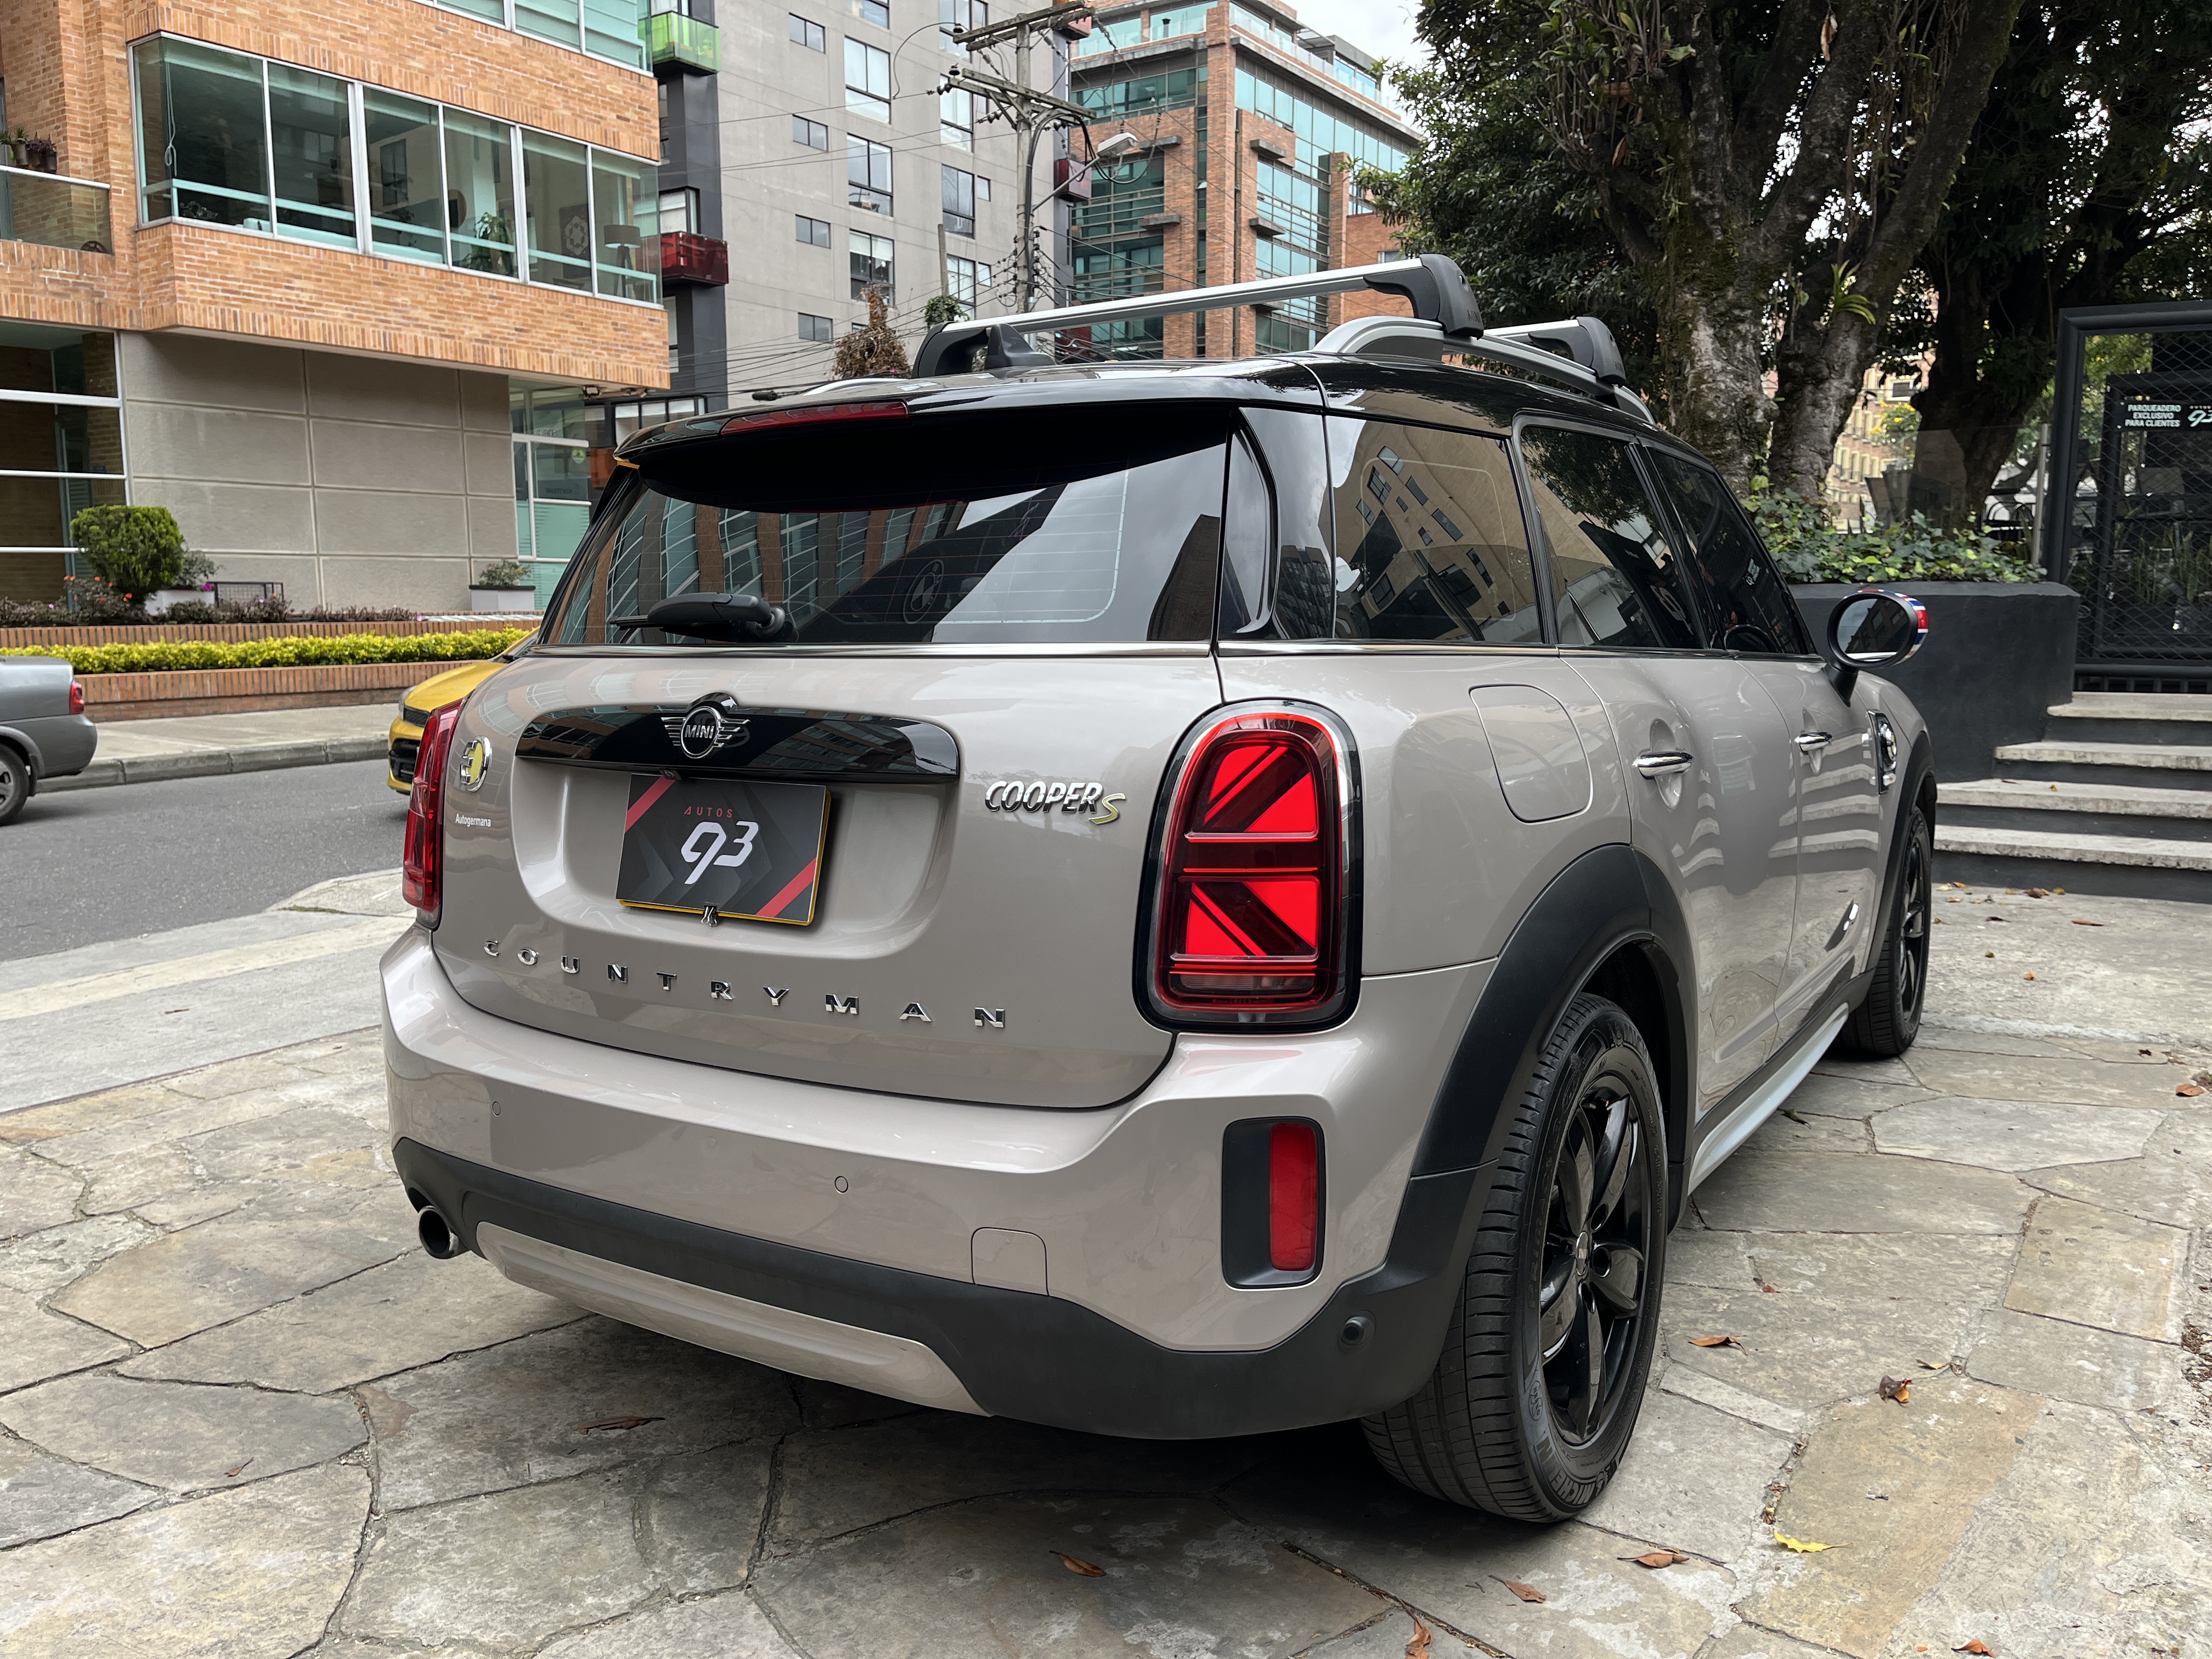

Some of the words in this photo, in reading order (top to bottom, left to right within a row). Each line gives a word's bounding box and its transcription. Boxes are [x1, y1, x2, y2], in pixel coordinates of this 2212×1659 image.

[684, 724, 715, 739] MINI
[455, 813, 492, 827] Autogermana
[684, 805, 733, 819] AUTOS
[985, 780, 1103, 814] COOPER
[1087, 792, 1126, 825] S
[681, 821, 759, 885] 93
[483, 939, 1006, 1029] COUNTRYMAN
[1536, 1436, 1595, 1504] MICHELIN
